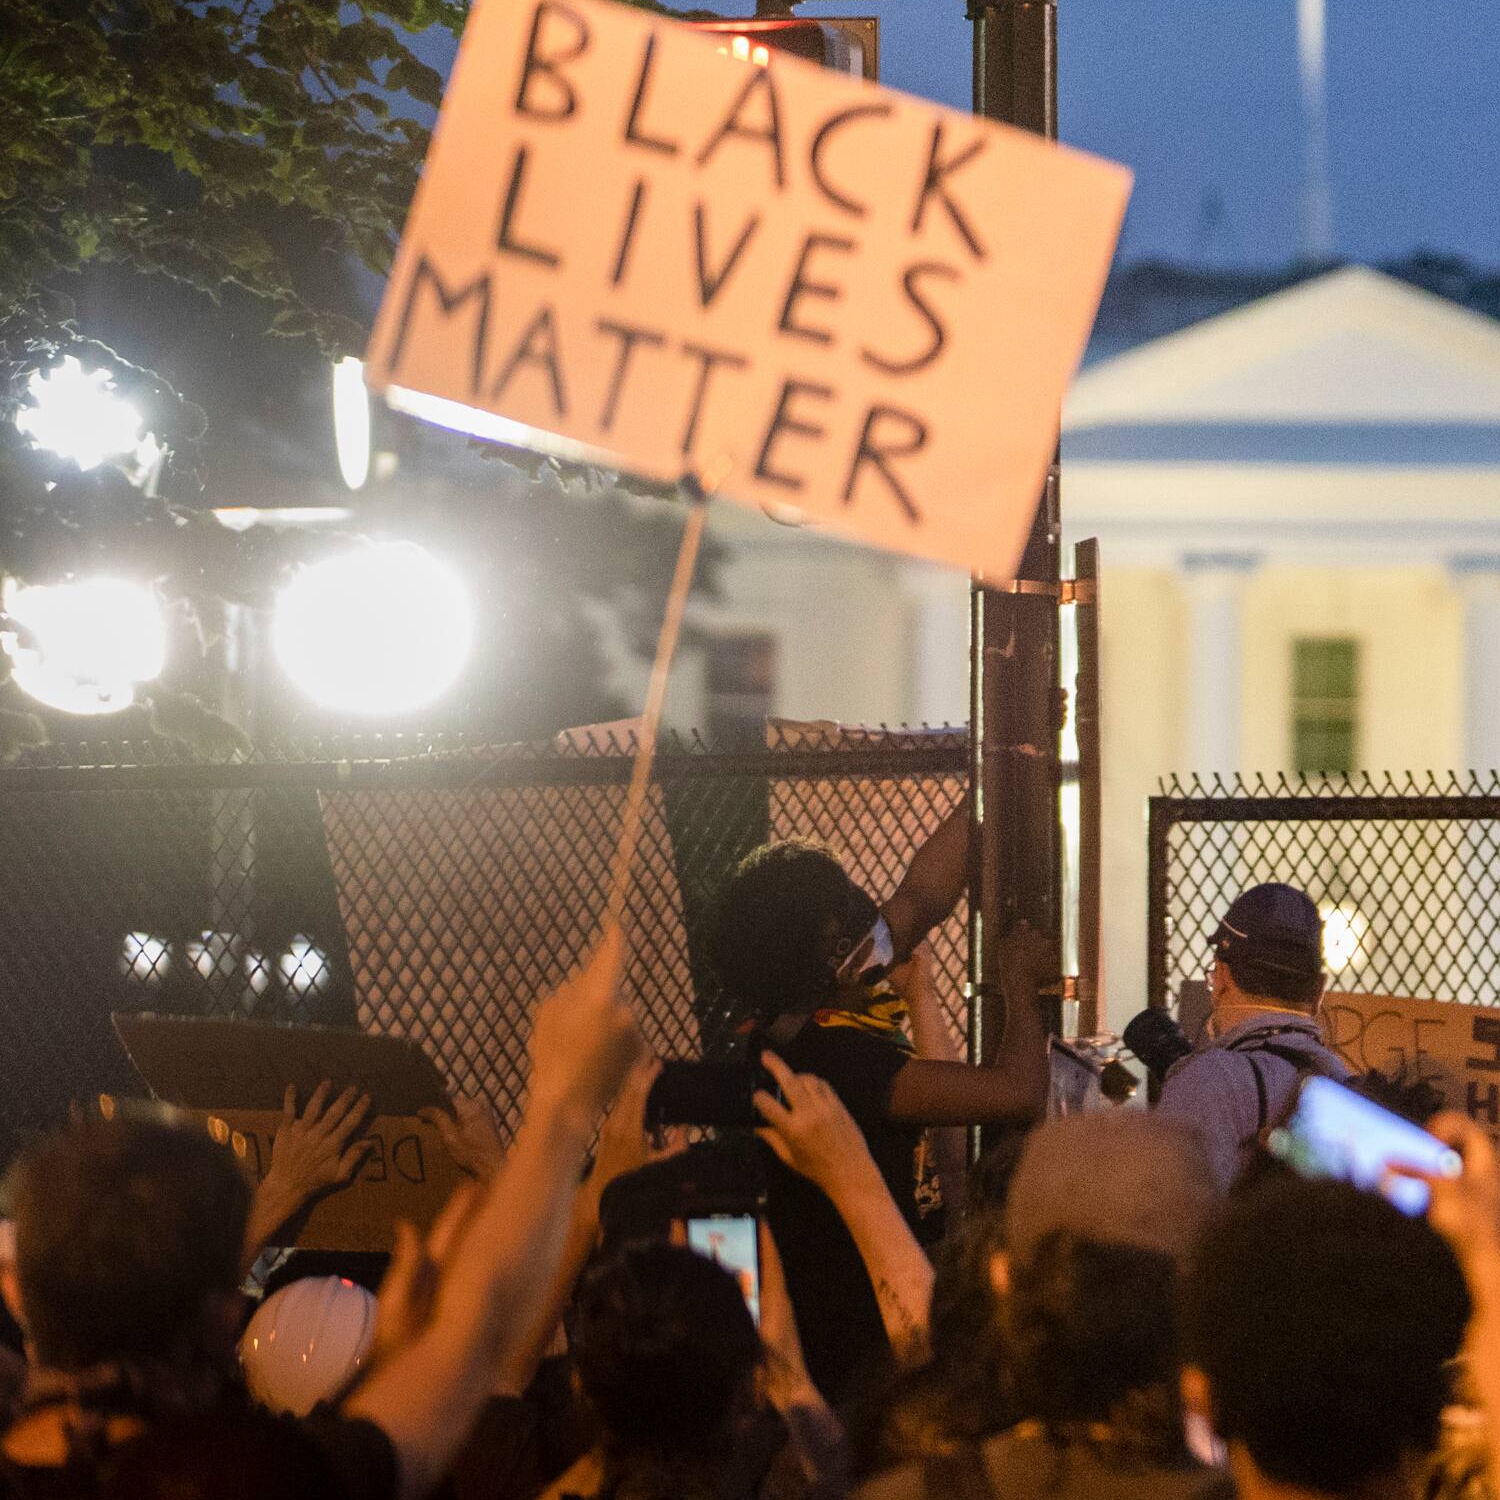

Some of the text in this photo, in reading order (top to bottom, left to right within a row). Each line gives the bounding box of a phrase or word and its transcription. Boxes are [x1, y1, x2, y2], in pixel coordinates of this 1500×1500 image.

[495, 145, 960, 376] LIVES
[514, 0, 988, 261] BLACK
[386, 254, 929, 525] MATTER
